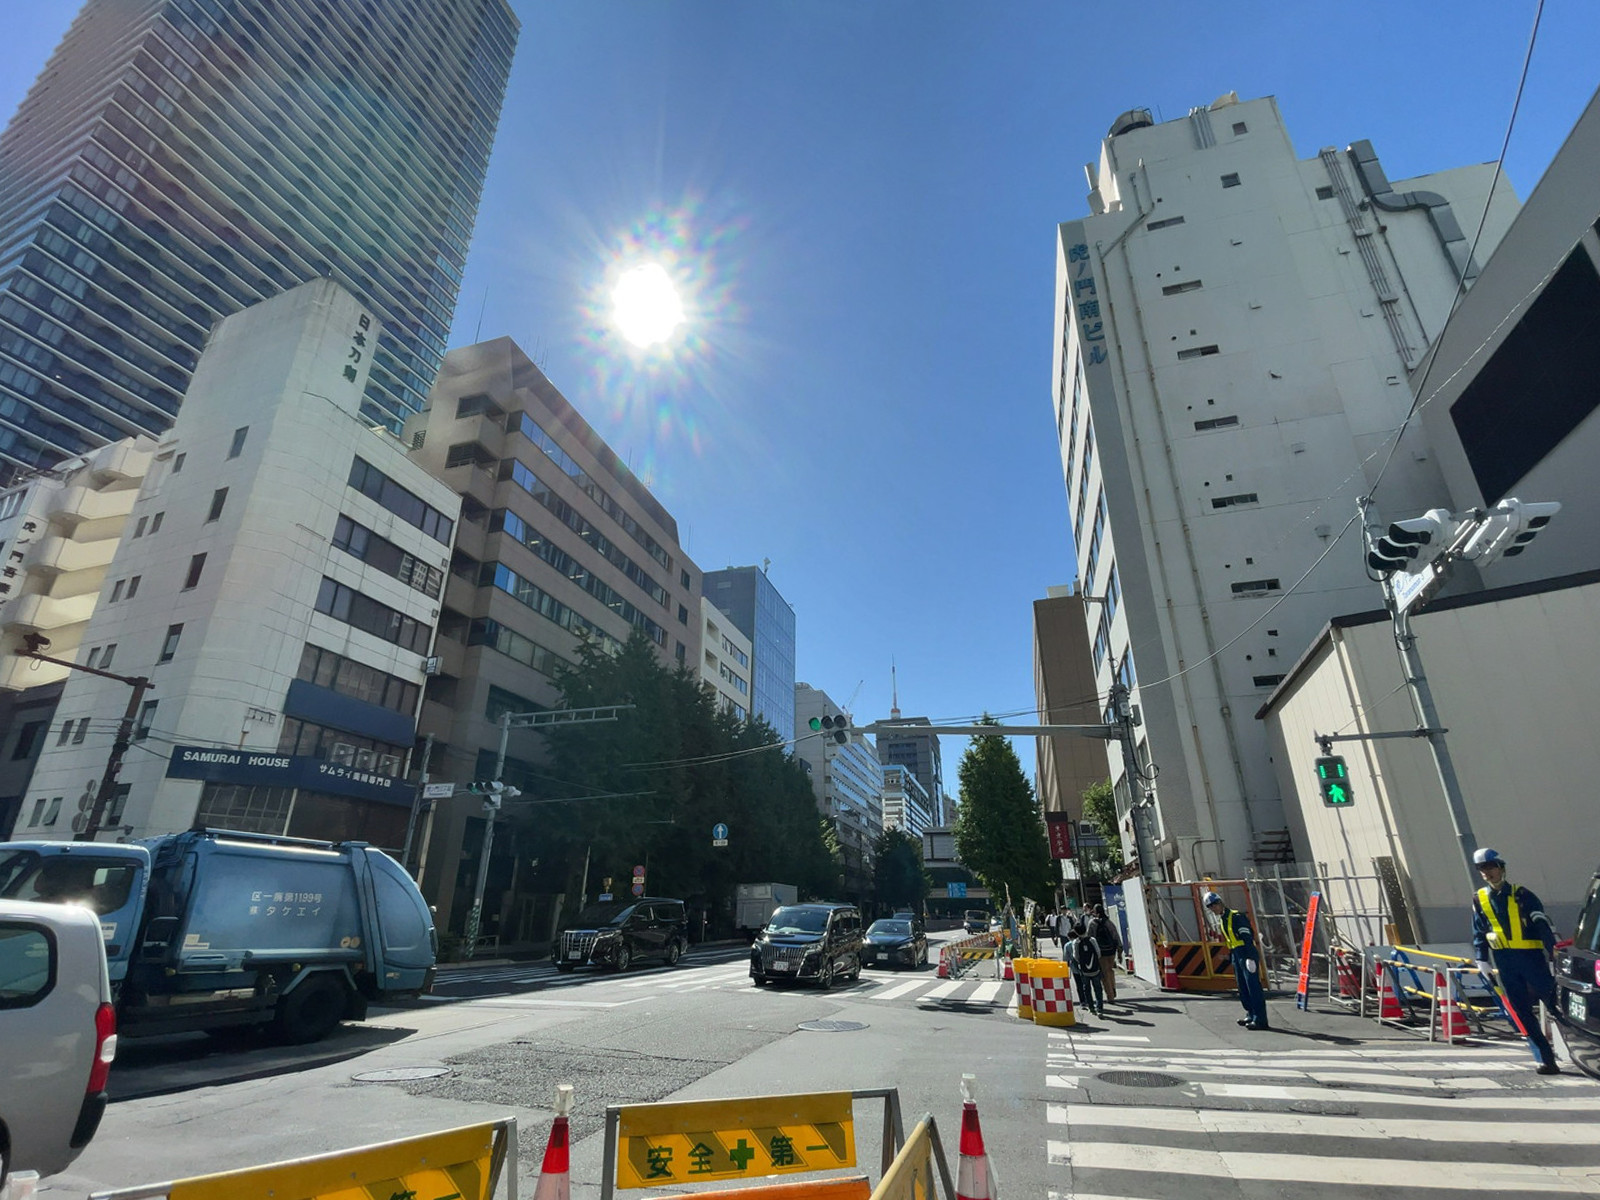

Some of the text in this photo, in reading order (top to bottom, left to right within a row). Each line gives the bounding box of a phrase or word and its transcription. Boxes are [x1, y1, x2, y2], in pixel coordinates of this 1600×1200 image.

[1068, 243, 1109, 367] 虎ノ門南ビル
[183, 750, 291, 769] SAMURAI HOUSE
